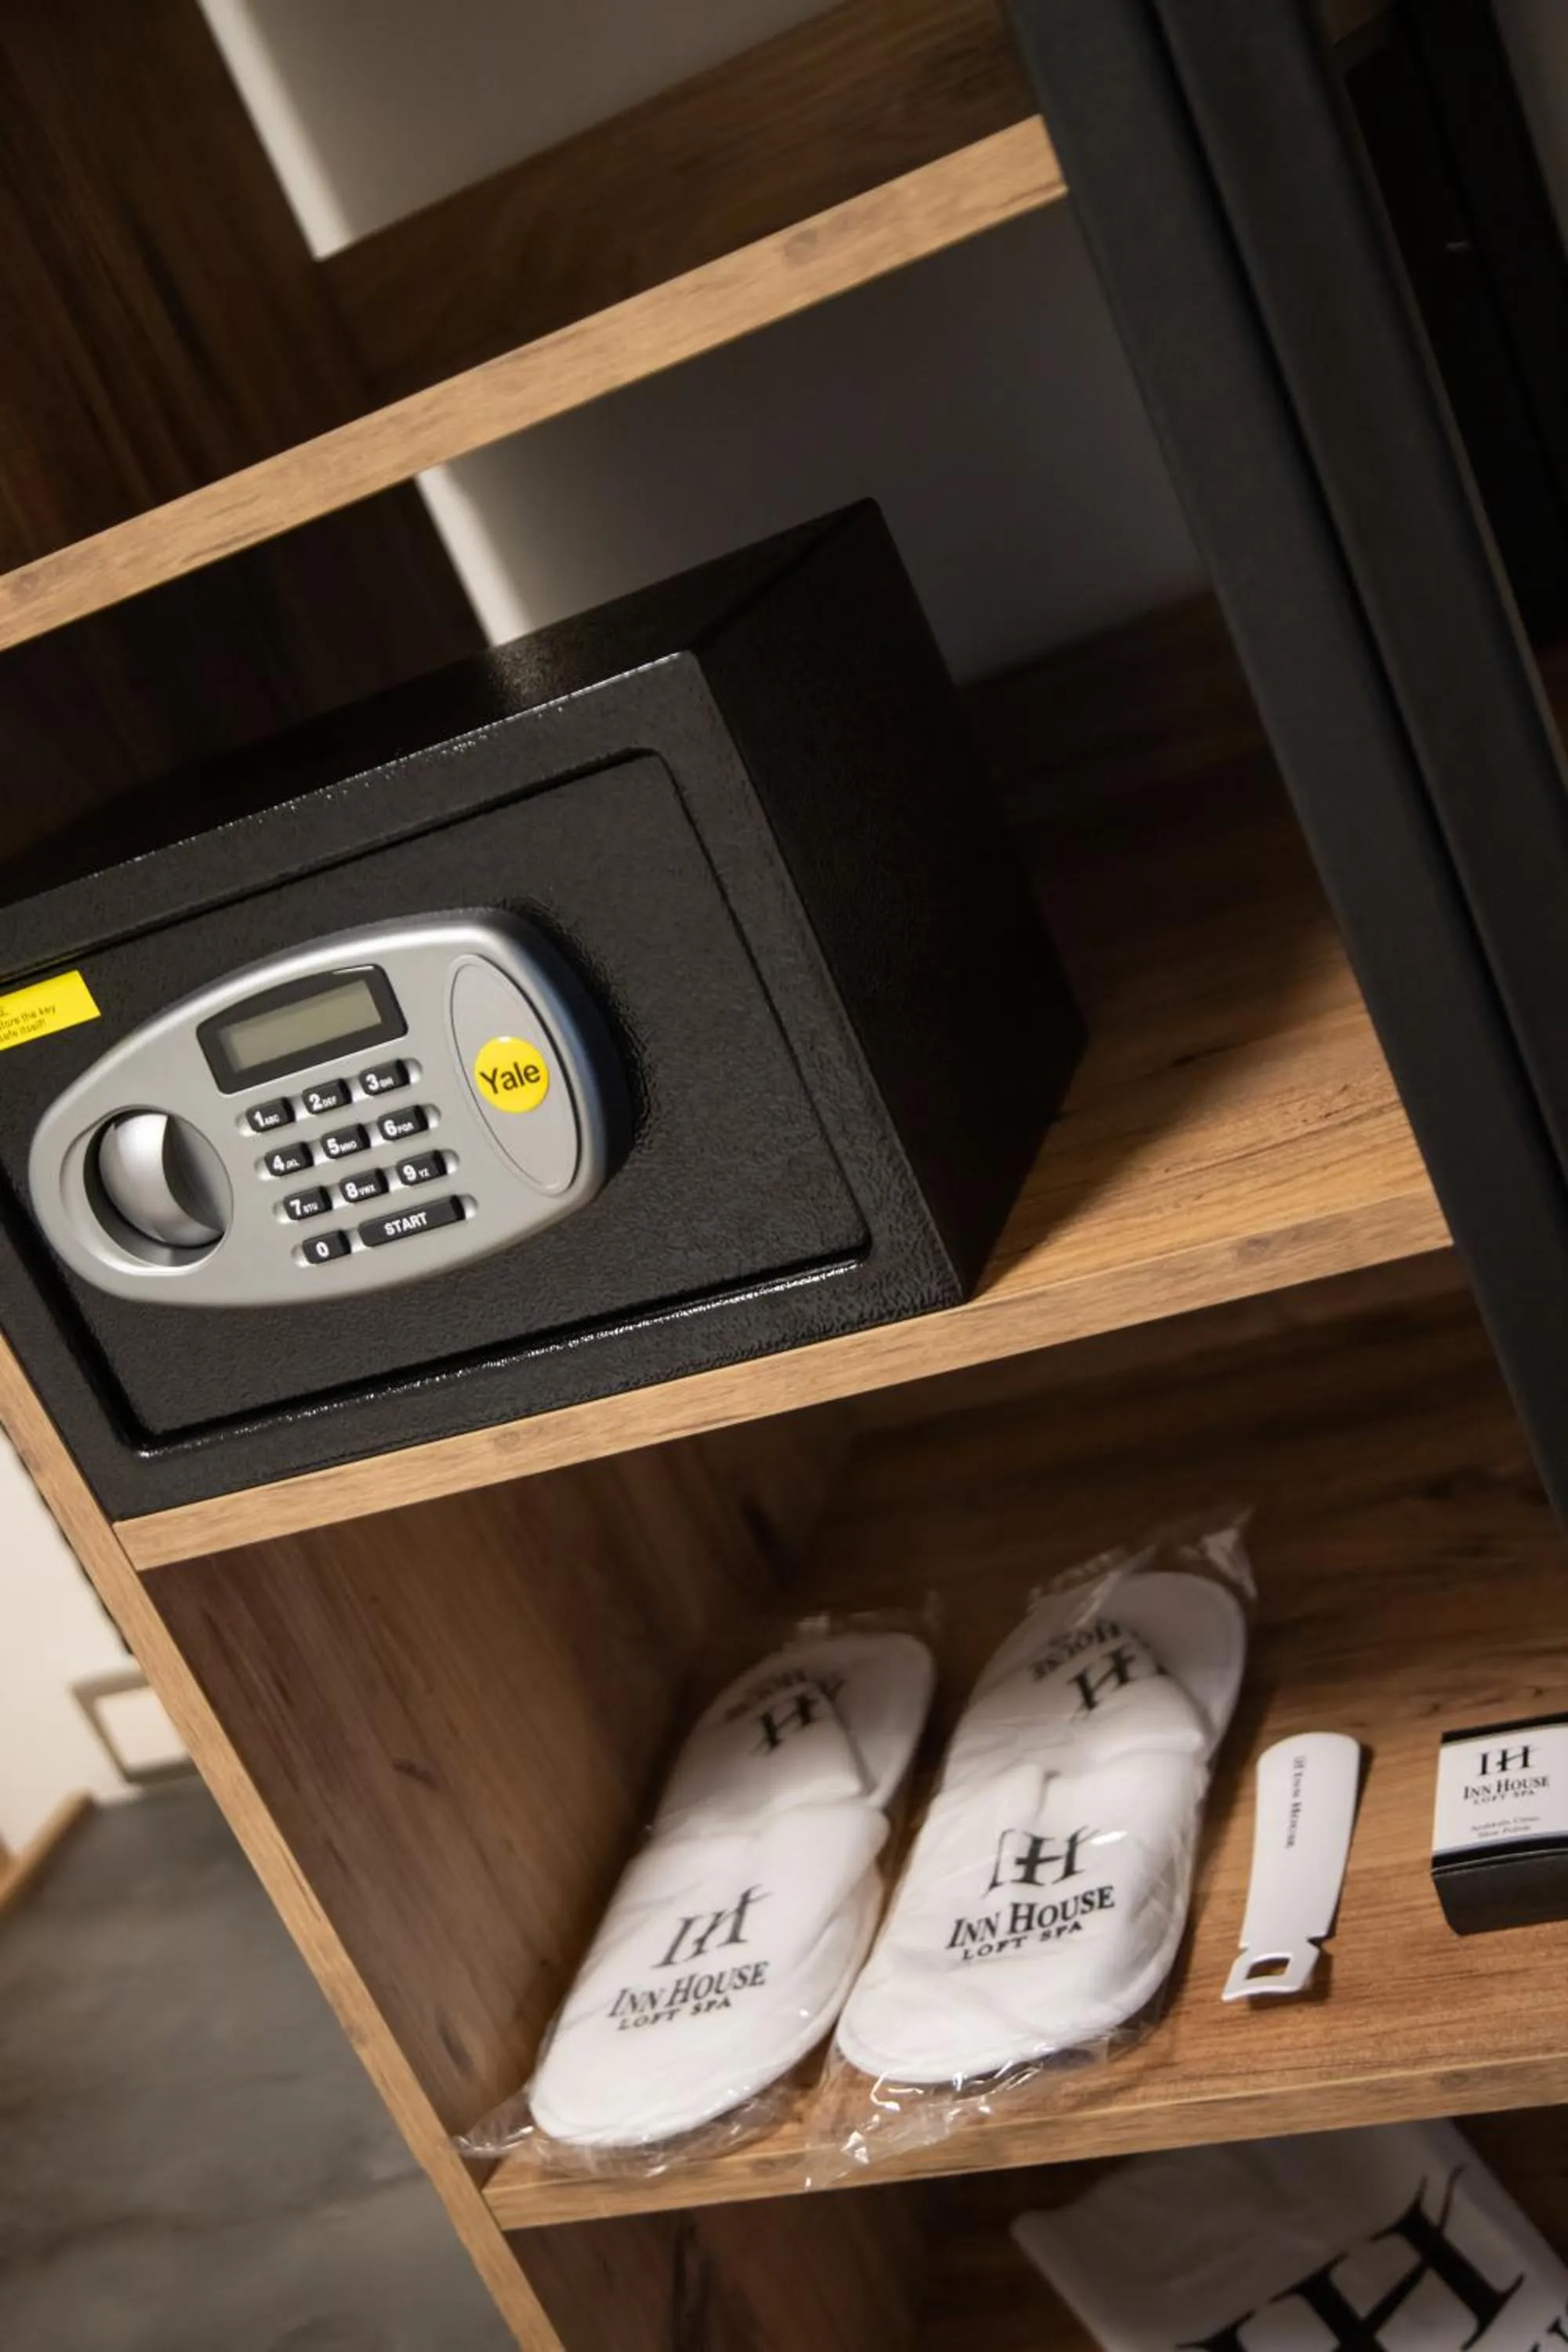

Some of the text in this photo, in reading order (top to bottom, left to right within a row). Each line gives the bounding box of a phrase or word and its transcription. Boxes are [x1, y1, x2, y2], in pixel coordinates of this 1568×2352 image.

[38, 1004, 56, 1015] key
[479, 1062, 540, 1094] Yale
[384, 1212, 428, 1236] START
[316, 1242, 328, 1258] 0
[1464, 1776, 1549, 1800] INN HOUSE
[946, 1886, 1115, 1949] INN HOUSE
[962, 1921, 1083, 1961] LOFT SPA
[607, 1961, 769, 2018] INN HOUSE
[617, 1997, 731, 2031] LOFT SPA
